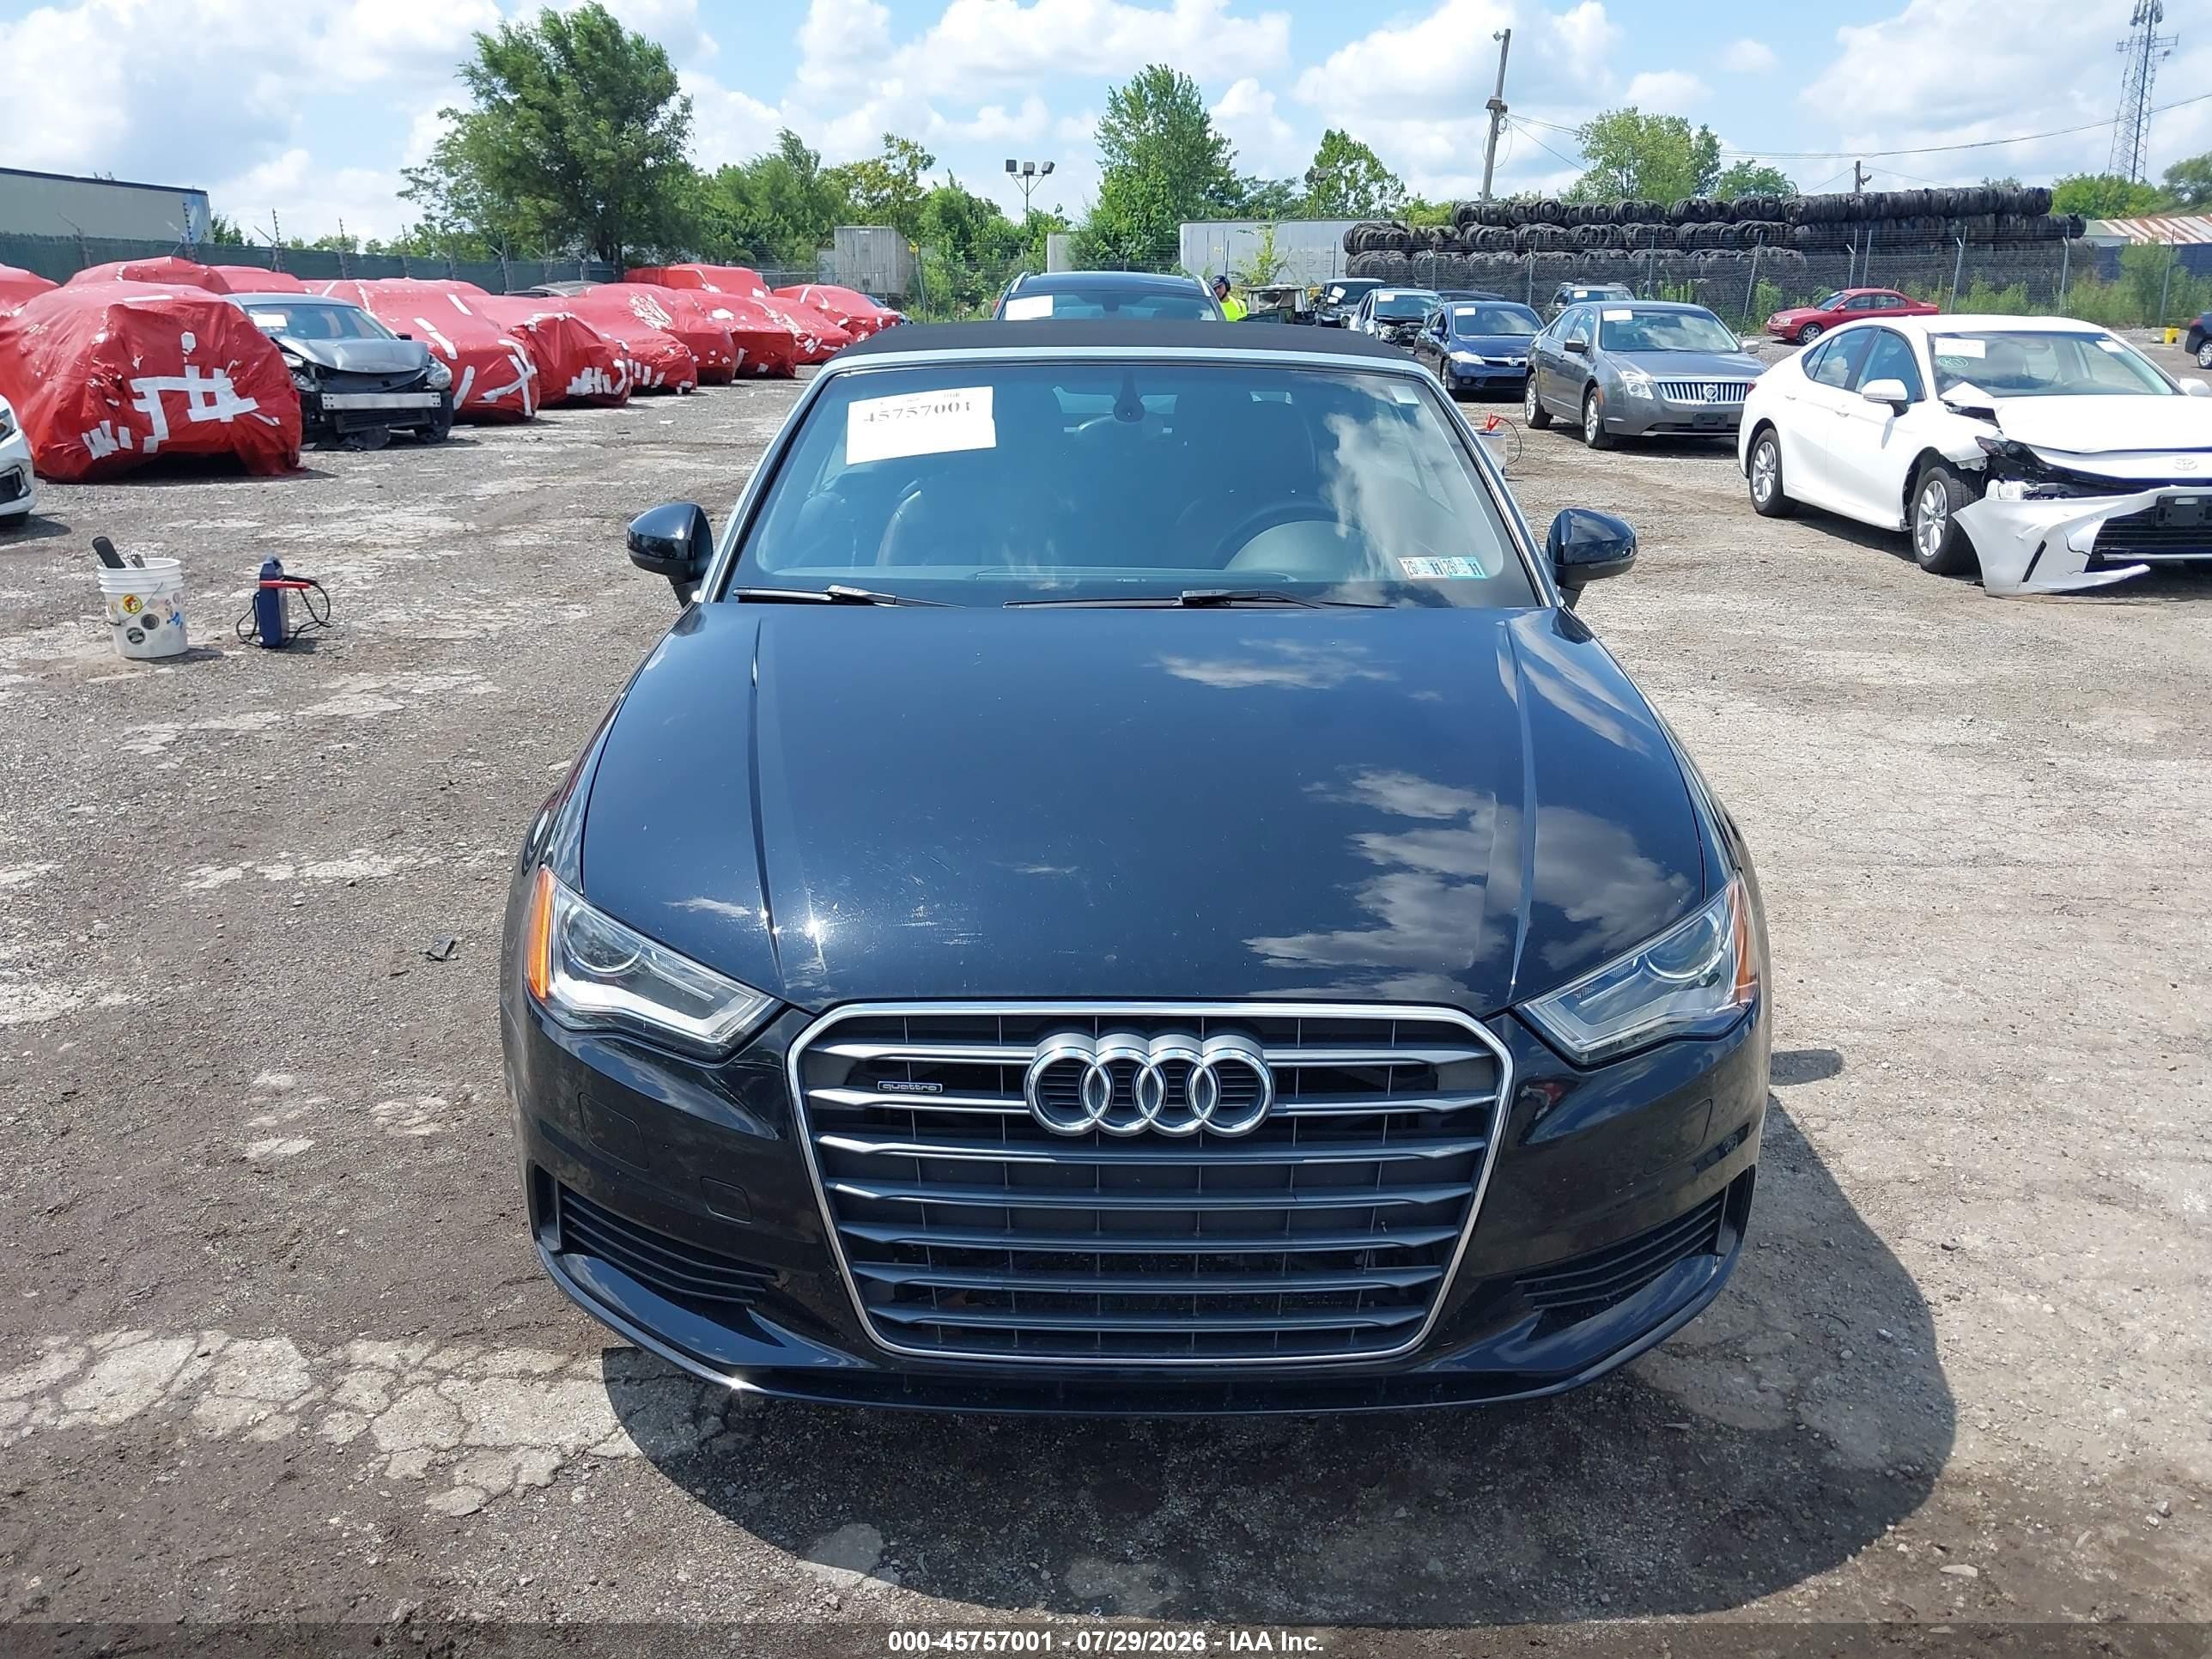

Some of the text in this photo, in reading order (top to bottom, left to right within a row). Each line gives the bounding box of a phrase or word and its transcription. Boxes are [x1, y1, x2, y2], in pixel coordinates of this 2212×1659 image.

[863, 401, 970, 422] 45757001
[1430, 562, 1444, 575] 11
[1468, 562, 1482, 576] 11
